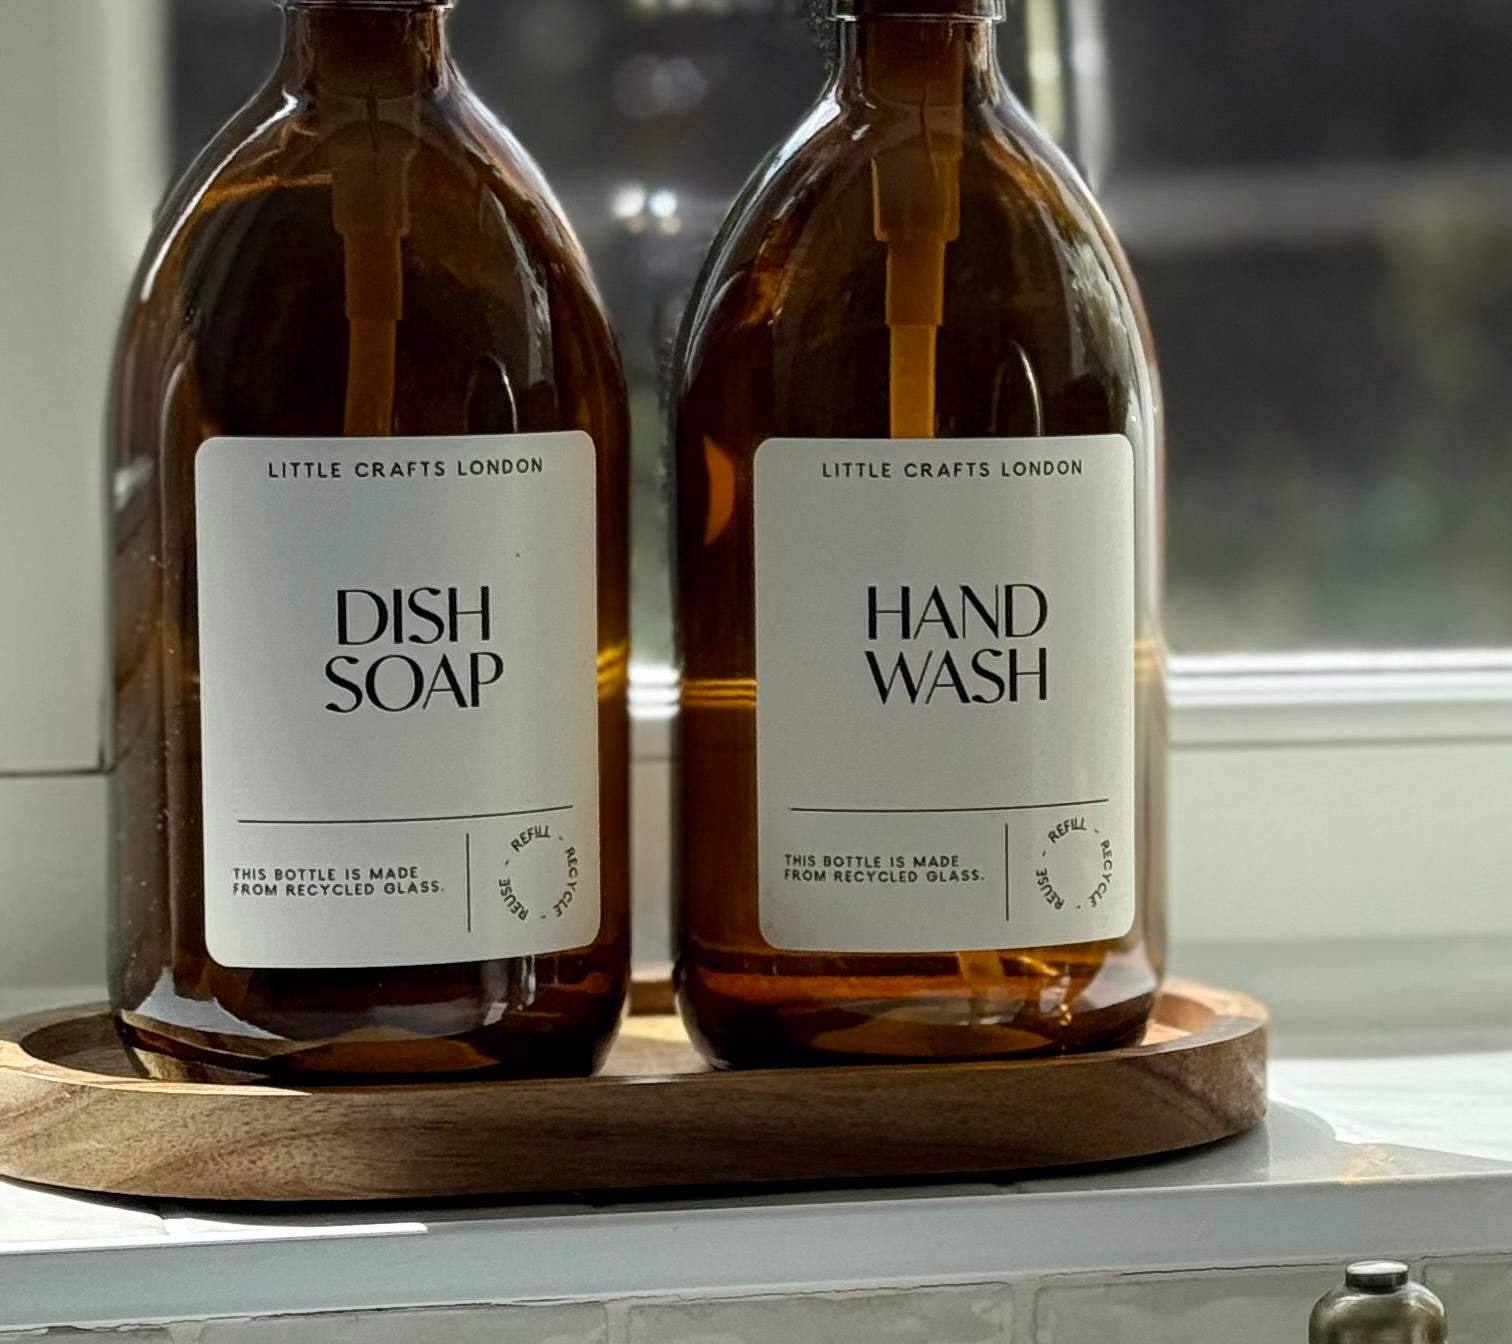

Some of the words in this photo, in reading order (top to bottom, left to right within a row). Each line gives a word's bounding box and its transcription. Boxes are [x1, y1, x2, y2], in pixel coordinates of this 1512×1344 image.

[267, 461, 342, 479] LITTLE
[354, 460, 446, 479] CRAFTS
[457, 457, 543, 477] LONDON
[821, 461, 892, 479] LITTLE
[903, 461, 991, 479] CRAFTS
[1000, 458, 1083, 478] LONDON
[336, 585, 491, 646] DISH
[867, 583, 1049, 641] HAND
[324, 651, 504, 714] SOAP
[863, 646, 1048, 706] WASH
[511, 824, 551, 852] REFILL
[1047, 816, 1087, 844] REFILL
[232, 867, 267, 882] THIS
[273, 868, 337, 882] BOTTLE
[344, 868, 362, 881] IS
[369, 866, 419, 881] MADE
[783, 854, 817, 868] THIS
[822, 855, 882, 869] BOTTLE
[889, 856, 906, 869] IS
[912, 854, 960, 868] MADE
[783, 868, 827, 883] FROM
[833, 869, 919, 884] RECYCLED
[926, 868, 986, 883] GLASS.
[1087, 839, 1113, 909] RECYCLE
[232, 882, 278, 896] FROM
[285, 882, 375, 897] RECYCLED
[383, 879, 445, 895] GLASS.
[498, 877, 529, 921] REUSE
[553, 846, 579, 918] RECYCLE
[1035, 867, 1065, 911] REUSE
